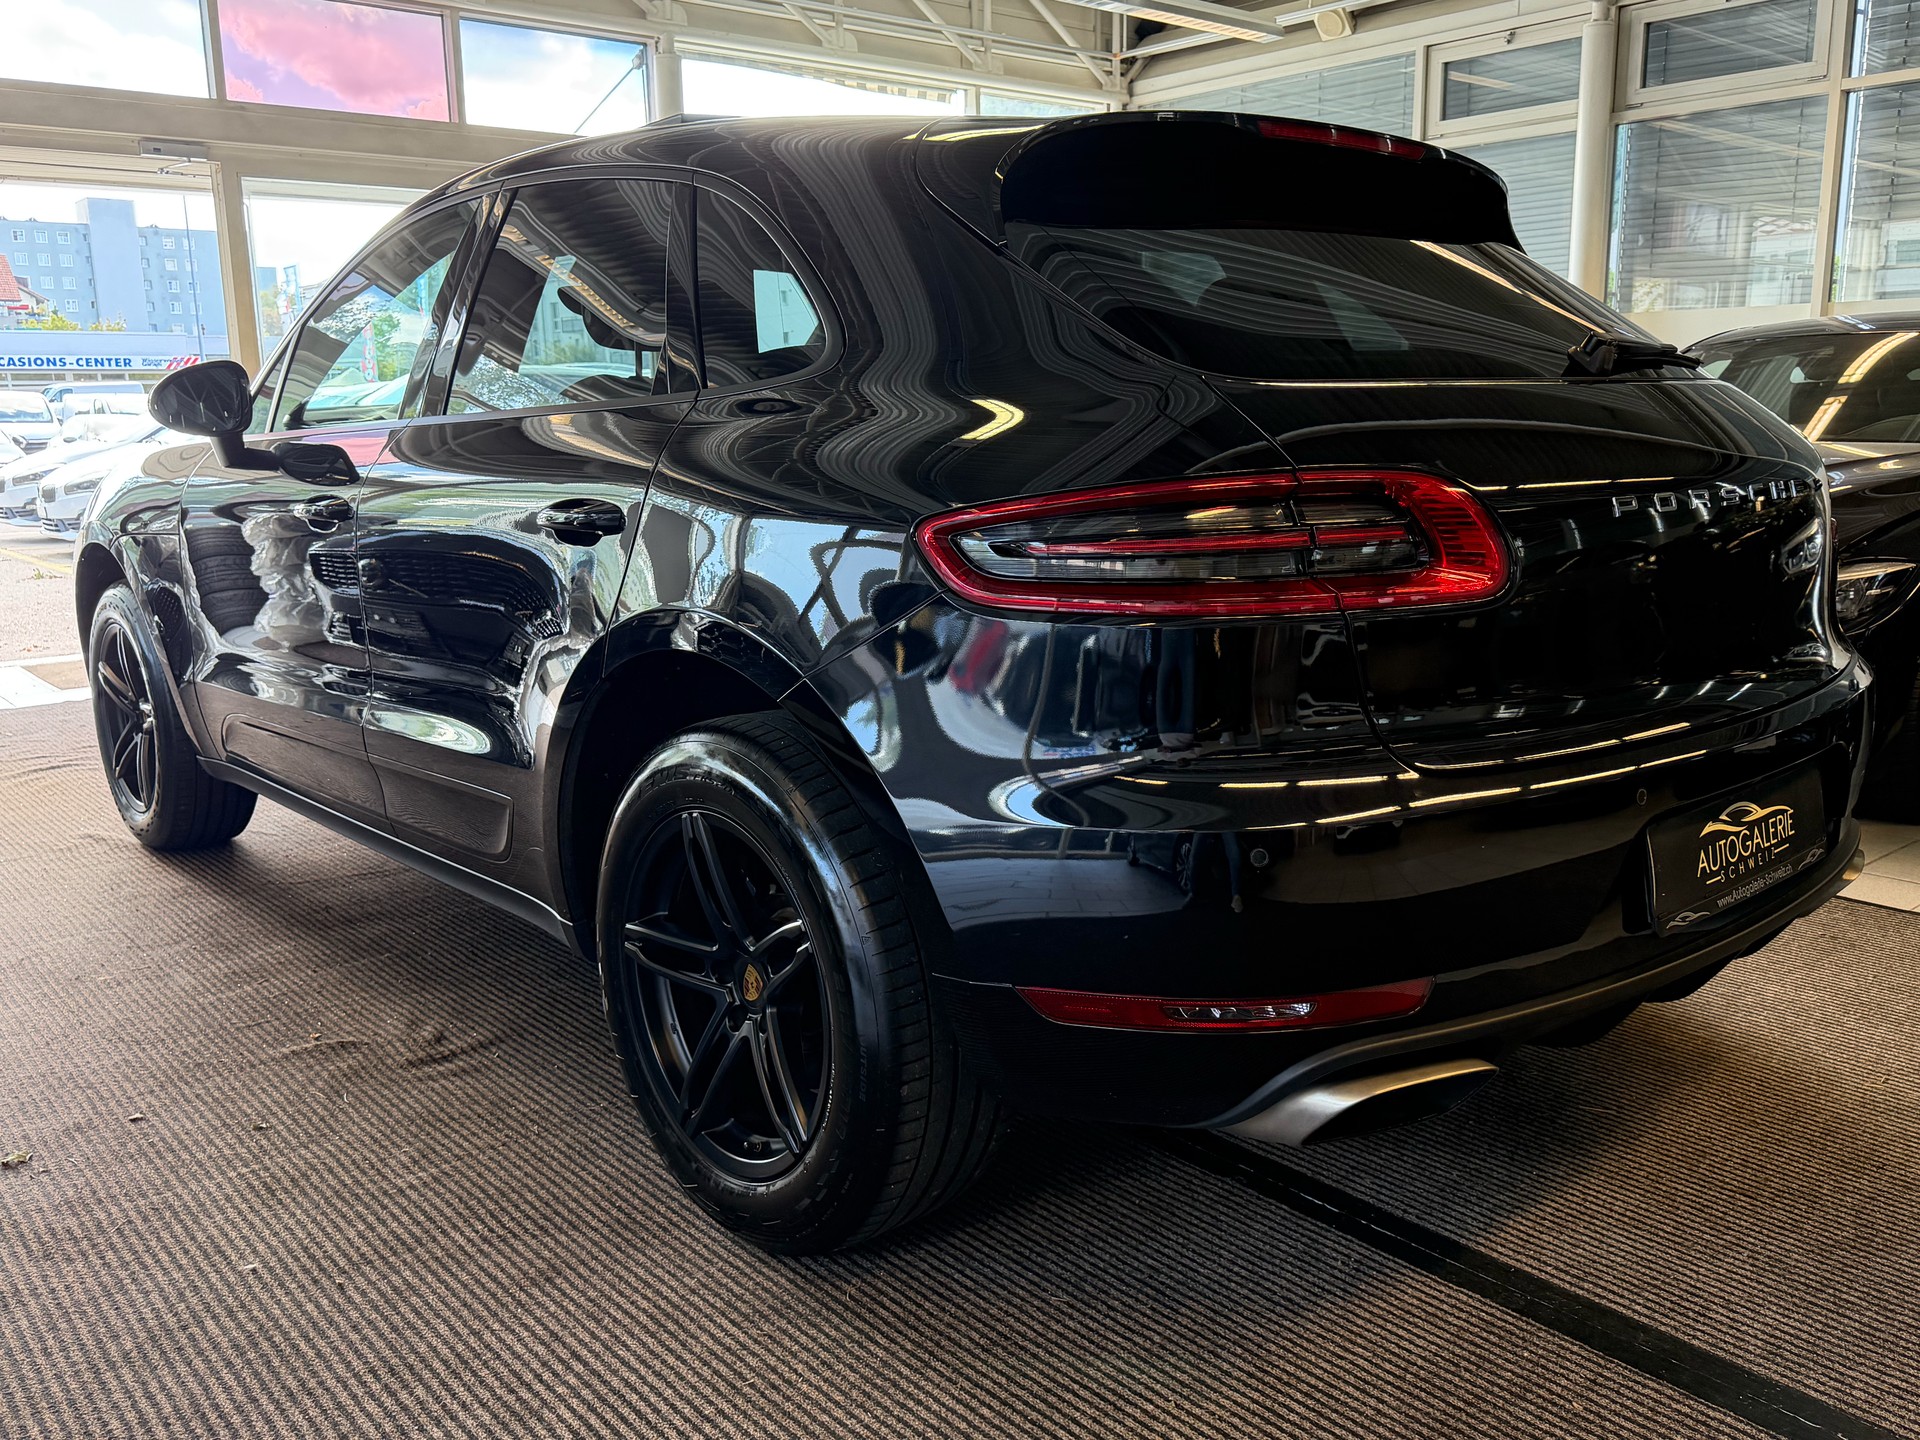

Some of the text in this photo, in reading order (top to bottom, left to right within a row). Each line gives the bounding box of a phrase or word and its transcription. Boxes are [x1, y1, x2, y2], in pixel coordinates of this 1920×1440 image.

[1612, 479, 1805, 517] PORSCHE
[1697, 810, 1795, 878] AUTOGALERIE
[1720, 847, 1776, 883] SCHWEIZ
